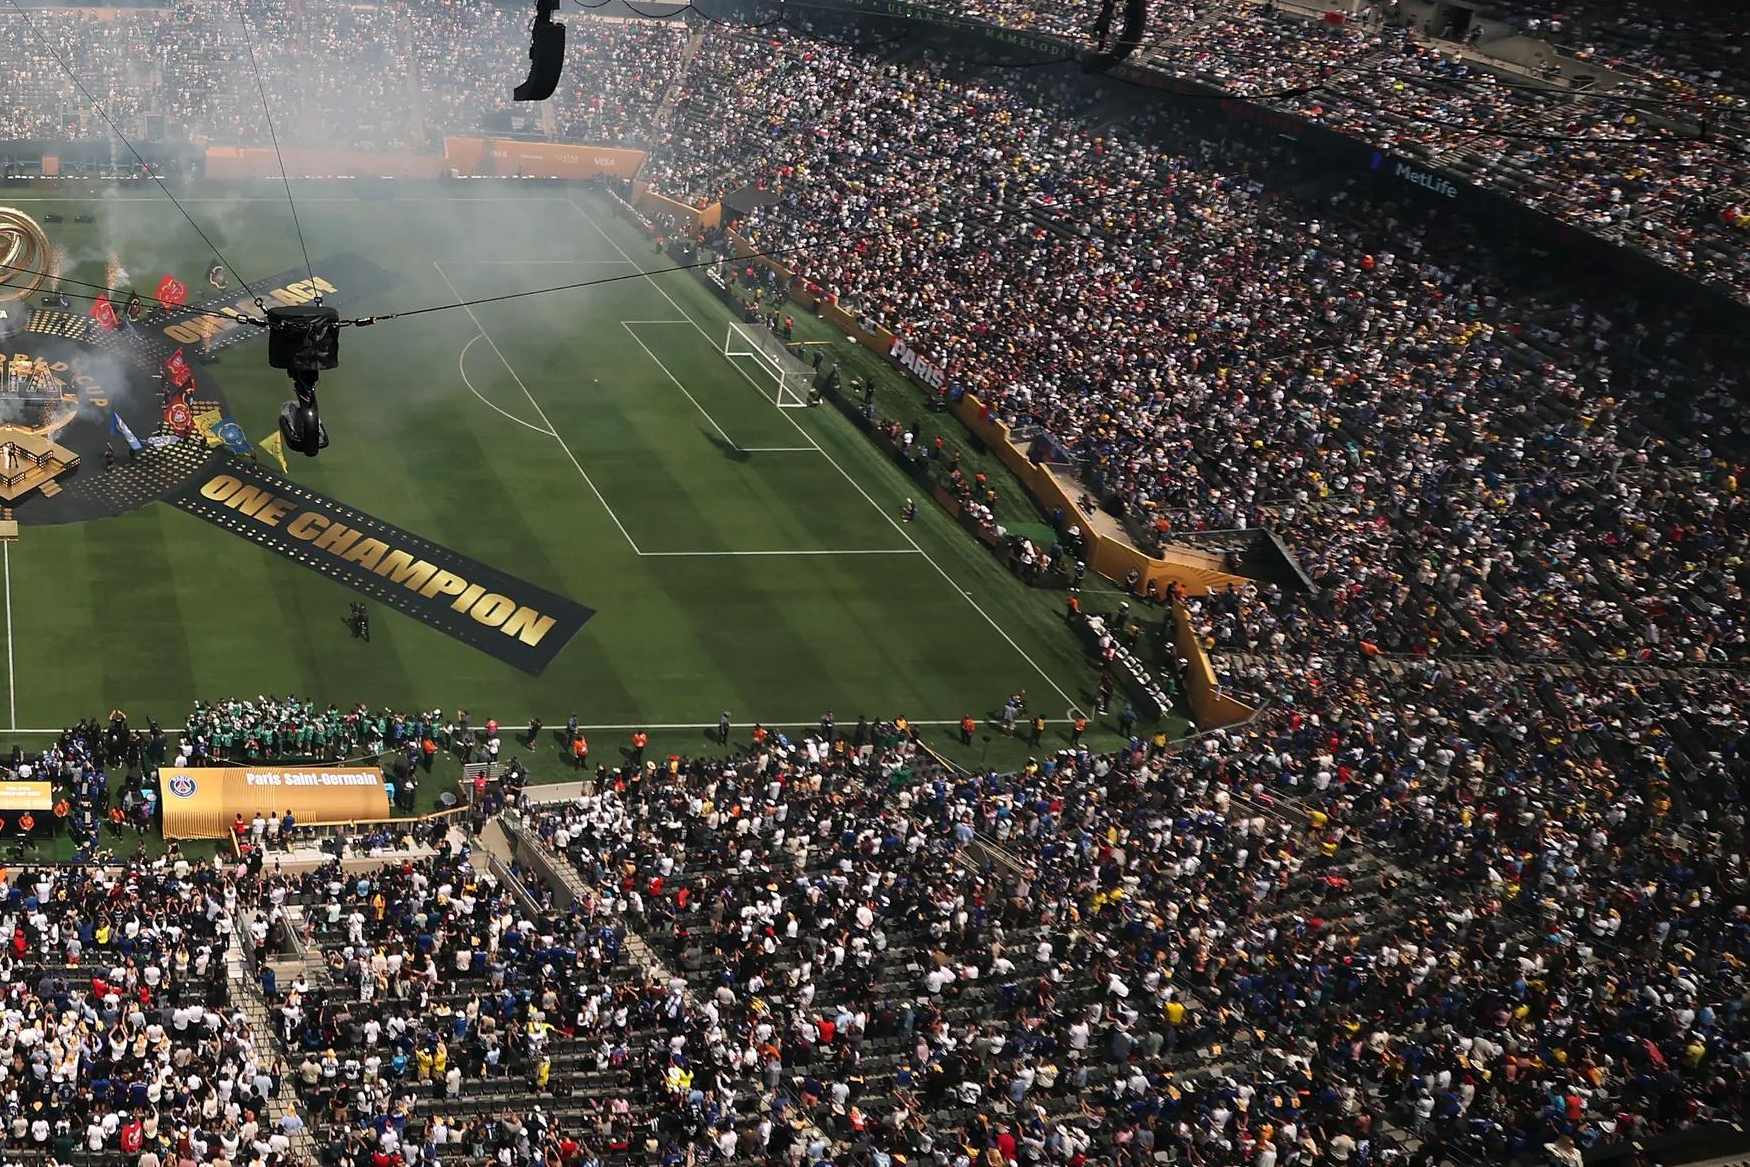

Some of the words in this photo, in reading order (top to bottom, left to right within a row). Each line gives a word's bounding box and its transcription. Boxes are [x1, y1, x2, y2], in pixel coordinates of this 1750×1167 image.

[594, 156, 615, 167] VISA
[1395, 162, 1457, 198] MetLife
[220, 276, 338, 322] LACY
[890, 338, 946, 390] PARIS
[200, 474, 297, 527] ONE
[286, 510, 557, 647] CHAMPION
[245, 772, 282, 786] Paris
[283, 772, 378, 786] Saint-Germain
